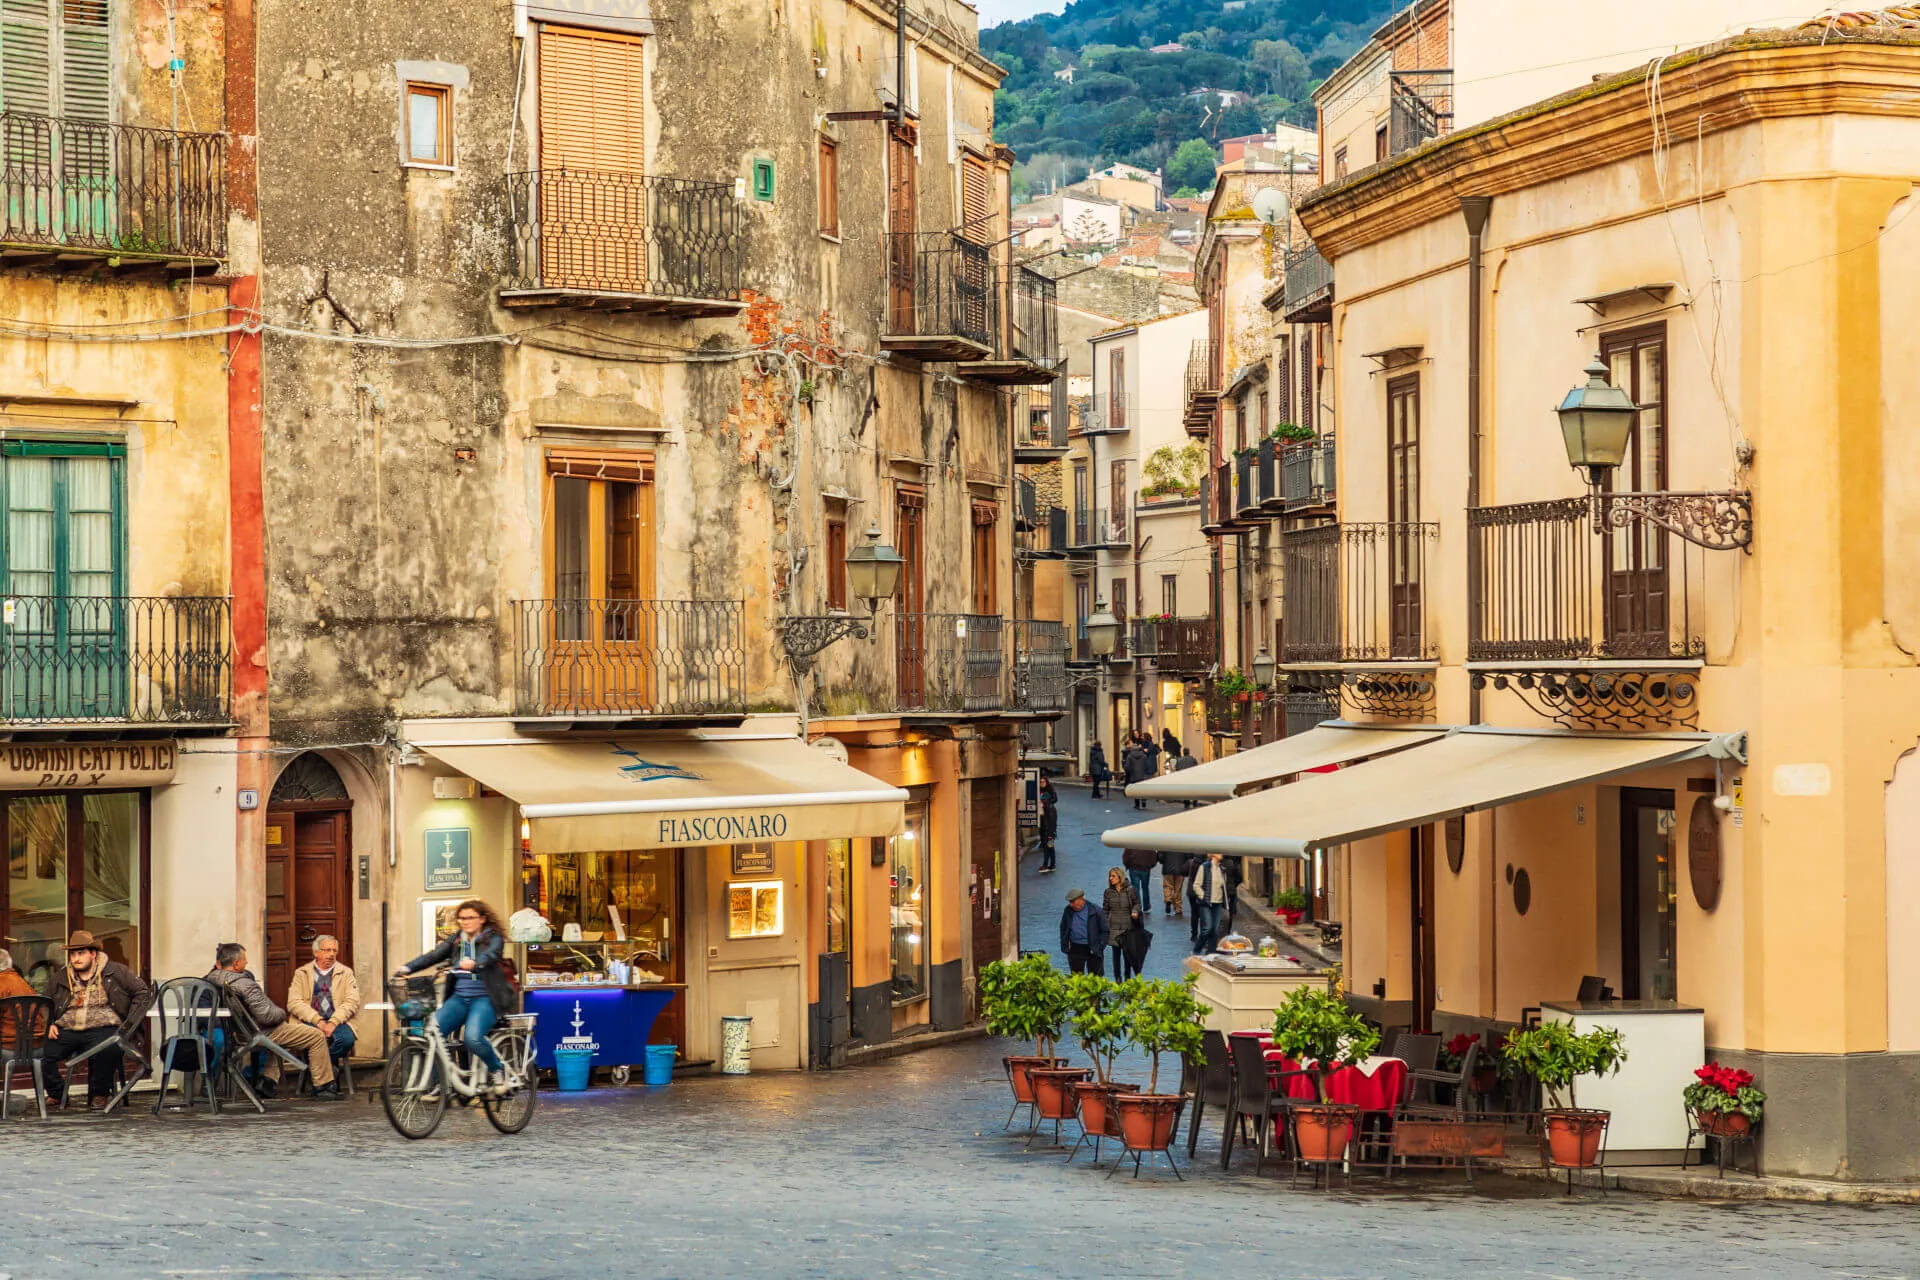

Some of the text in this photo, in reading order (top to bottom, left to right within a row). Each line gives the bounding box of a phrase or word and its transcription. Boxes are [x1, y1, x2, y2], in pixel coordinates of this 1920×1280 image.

[8, 747, 74, 771] UOMINI
[79, 745, 174, 771] CATTOLICI
[38, 773, 106, 787] PIO X
[245, 792, 253, 805] 9
[658, 813, 787, 843] FIASCONARO
[737, 858, 771, 869] FIASCONARO
[556, 1042, 600, 1051] FIASCONARO
